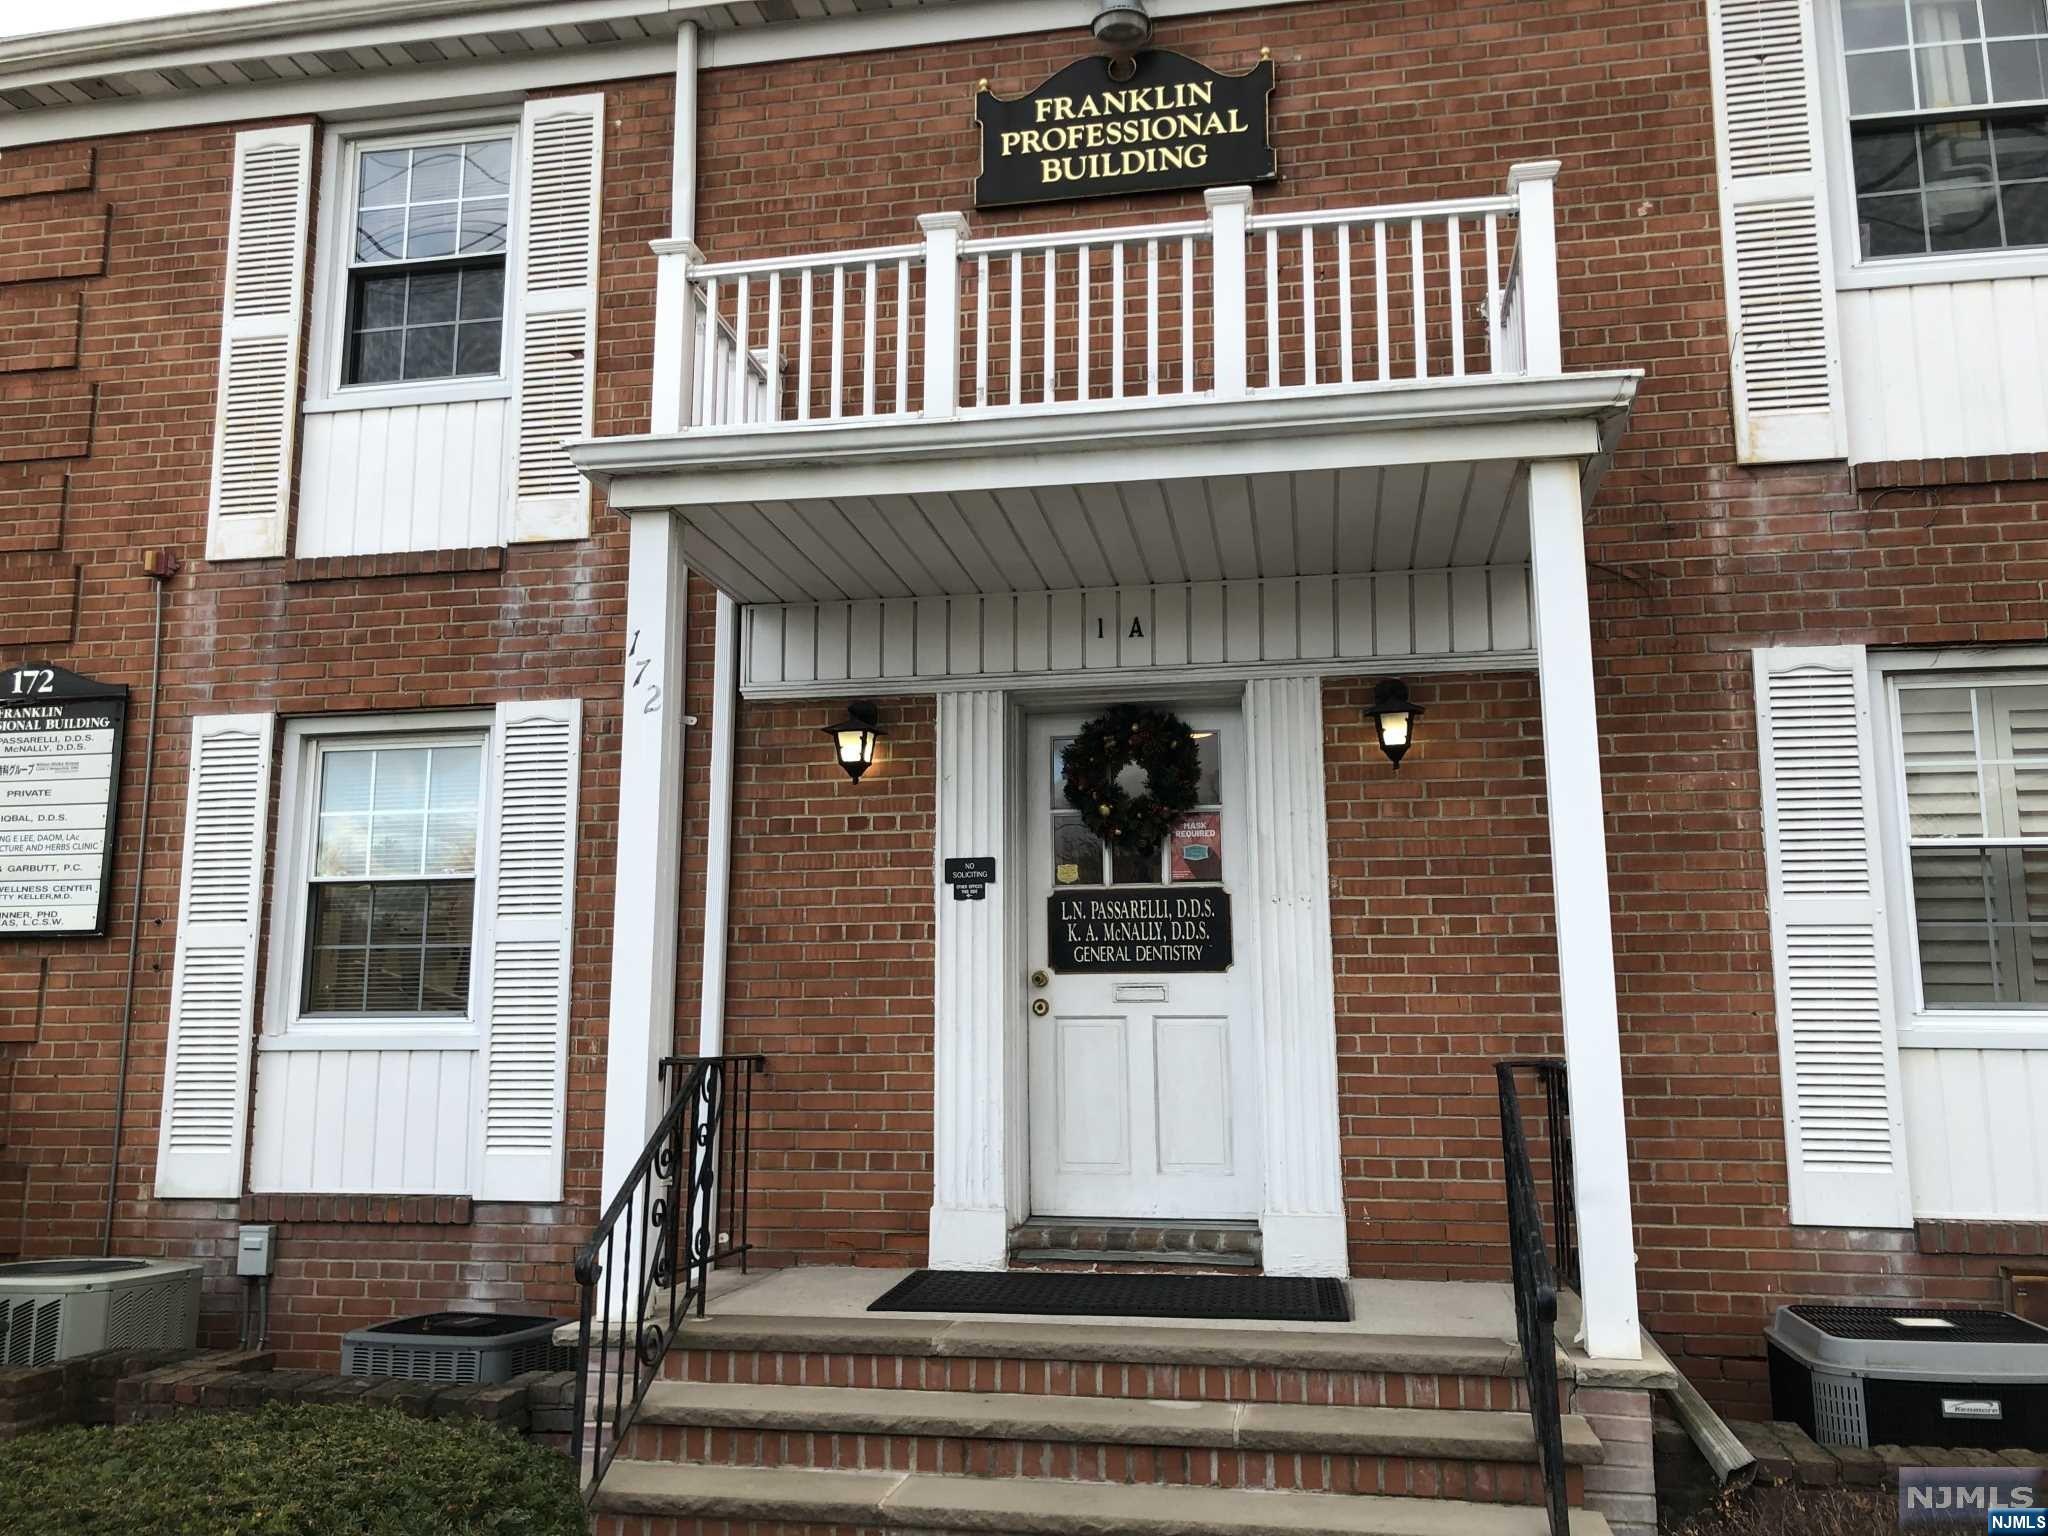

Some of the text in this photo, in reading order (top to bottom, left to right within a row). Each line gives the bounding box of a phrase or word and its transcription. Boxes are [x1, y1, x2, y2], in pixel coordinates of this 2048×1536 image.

[1035, 81, 1213, 123] FRANKLIN
[1001, 109, 1249, 156] PROFESSIONAL
[1041, 144, 1208, 183] BUILDING
[1128, 616, 1144, 637] A
[628, 630, 661, 714] 172
[12, 669, 55, 694] 172
[46, 717, 110, 730] BUILDING
[65, 734, 94, 742] D.D.S.
[4, 743, 87, 753] McNALLY, D.D.S.
[7, 789, 52, 798] PRIVATE
[1184, 822, 1207, 830] MASK
[1175, 829, 1216, 838] REQUIRED
[26, 844, 43, 852] AND
[45, 843, 70, 851] HERBS
[72, 842, 98, 850] CLINIC
[964, 862, 975, 870] NO
[952, 870, 988, 879] SOLICITING
[52, 884, 93, 892] CENTER
[37, 910, 58, 918] PHD
[1062, 899, 1215, 921] L.N. PASSARELLI, D.D.S.
[1068, 921, 1210, 942] K. A. McNALLY, D.D.S.
[1074, 945, 1203, 962] GENERAL DENTISTRY
